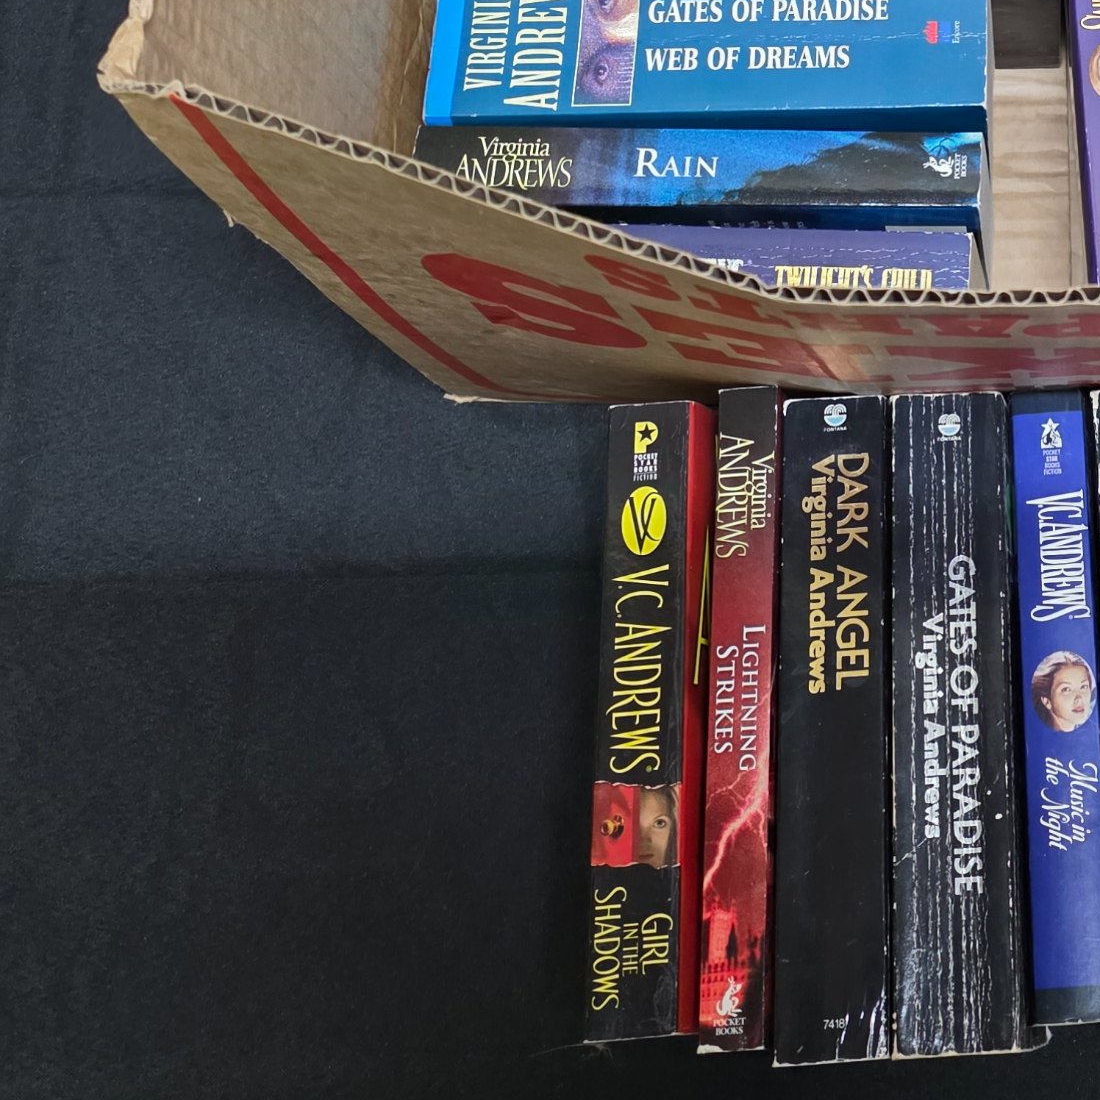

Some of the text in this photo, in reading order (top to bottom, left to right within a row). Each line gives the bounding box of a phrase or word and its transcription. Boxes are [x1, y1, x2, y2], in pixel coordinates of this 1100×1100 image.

[648, 0, 723, 24] GATES
[951, 20, 961, 44] Encore
[645, 45, 851, 72] WEB OF DREAMS
[454, 153, 573, 191] ANDREWS
[477, 135, 551, 163] Virginia
[823, 425, 848, 433] FONTANA
[715, 431, 755, 560] ANDREWS
[744, 450, 775, 530] Virginia
[802, 454, 836, 695] Virginia Andrews
[835, 452, 870, 691] DARK ANGEL
[713, 645, 739, 754] STRIKES
[738, 624, 766, 772] LIGHTNING
[915, 612, 949, 839] Virginia Andrews
[948, 554, 984, 896] GATES OF PARADISE
[1040, 756, 1073, 852] the Night
[1068, 759, 1099, 843] Music in
[591, 886, 628, 1011] SHADOWS
[622, 922, 639, 977] IN THE
[639, 912, 674, 976] GIRL
[713, 1016, 746, 1028] POCKET
[715, 1025, 744, 1036] BOOKS
